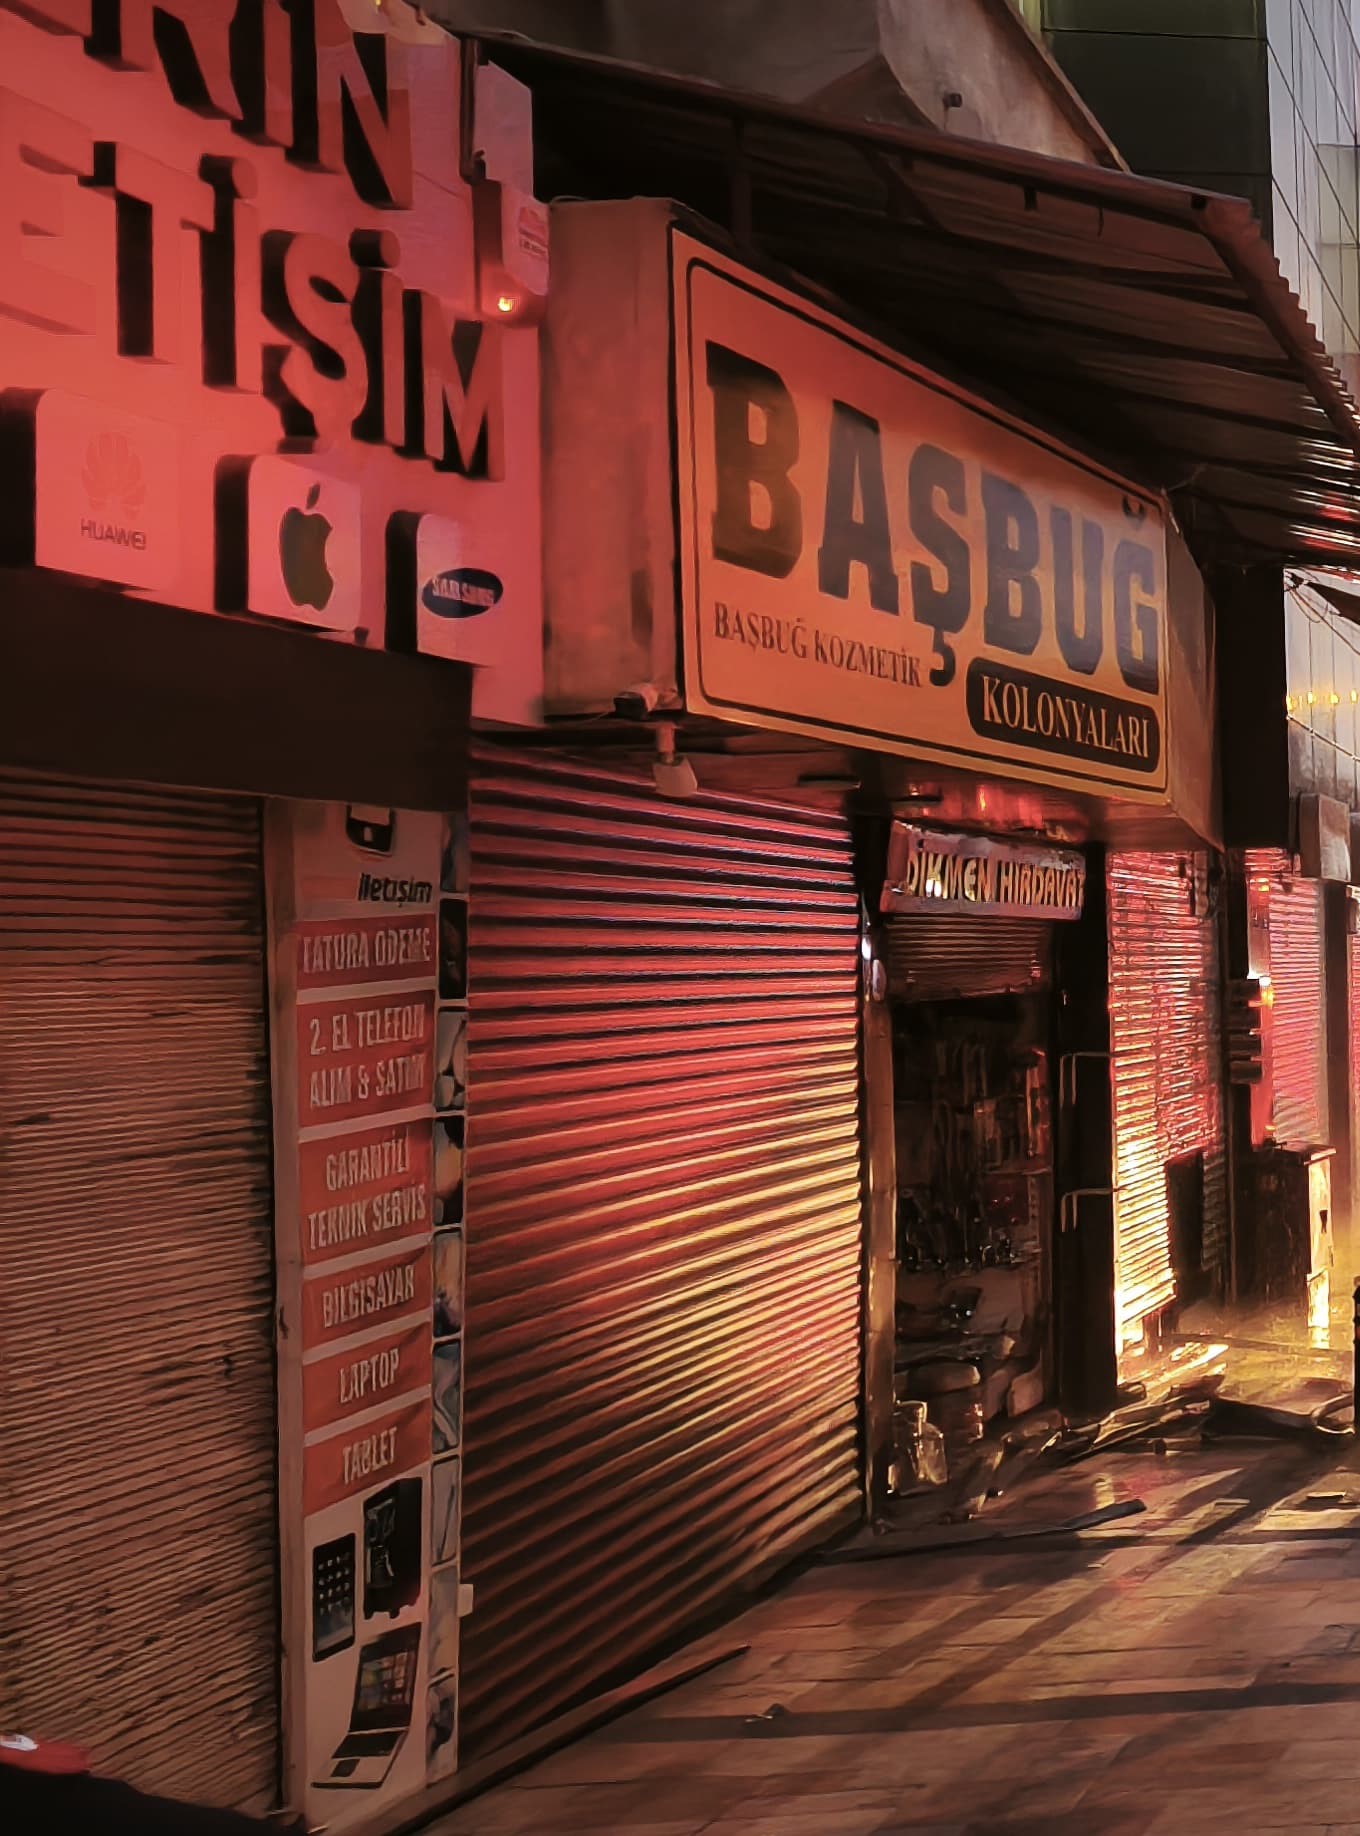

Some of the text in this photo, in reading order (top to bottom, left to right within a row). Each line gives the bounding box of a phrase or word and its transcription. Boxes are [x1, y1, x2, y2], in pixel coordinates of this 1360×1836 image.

[80, 518, 147, 551] HUAWEI
[705, 339, 1161, 696] BAŞBUĞ
[714, 601, 922, 688] BAŞBUĞ KOZMETİK
[981, 674, 1151, 758] KOLONYALARI
[332, 1014, 353, 1052] EL
[354, 1004, 426, 1048] TELEFON
[310, 1064, 353, 1110] ALIM
[358, 1064, 370, 1100] &
[339, 1348, 400, 1404] LAPTOP
[342, 1426, 398, 1486] TABLET
